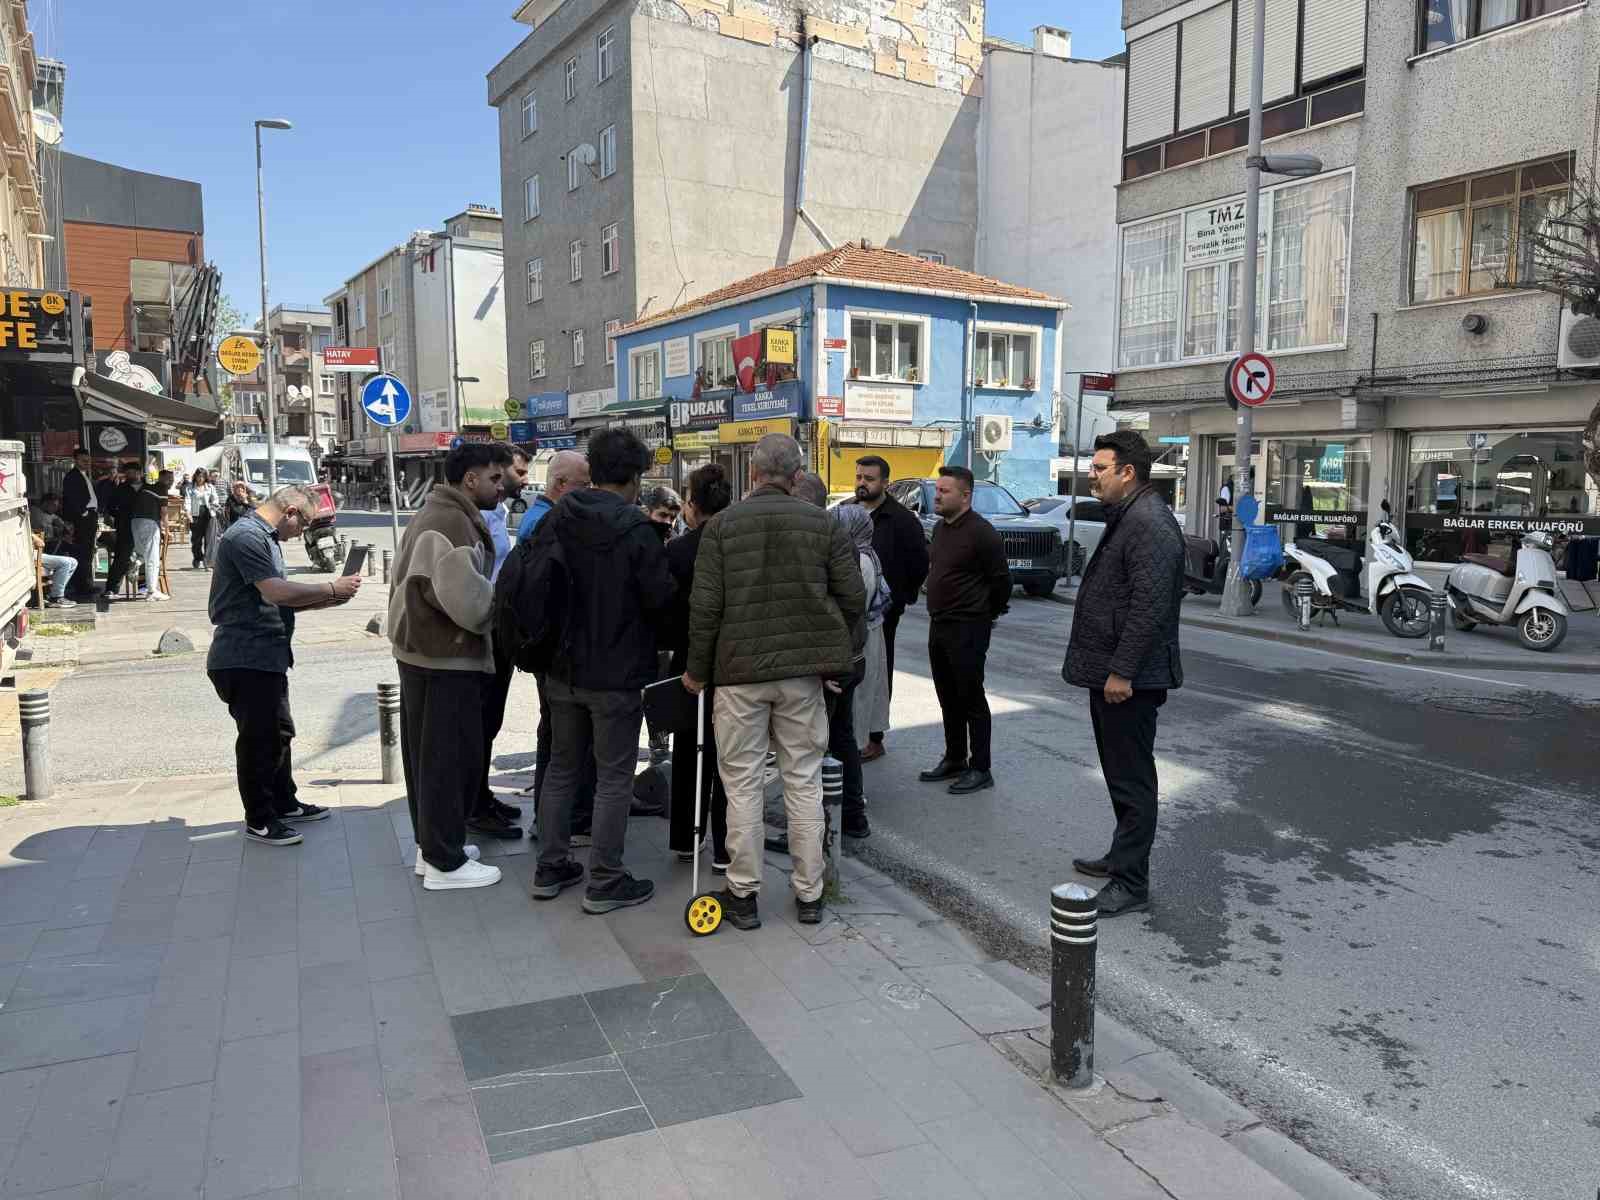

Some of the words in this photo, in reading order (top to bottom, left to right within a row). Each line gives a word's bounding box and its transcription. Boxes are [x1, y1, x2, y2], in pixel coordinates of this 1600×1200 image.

[1208, 203, 1245, 225] TMZ
[1197, 229, 1216, 239] Bina
[1218, 222, 1246, 233] Yöneti
[1188, 241, 1219, 253] Temizlik
[46, 295, 59, 305] BK
[769, 337, 790, 345] KANKA
[771, 344, 788, 353] TEKEL
[326, 350, 353, 360] HATAY
[754, 391, 773, 402] KANKA
[680, 399, 728, 425] BURAK
[742, 403, 757, 413] TEKEL
[1273, 512, 1299, 522] BAĞLAR
[1301, 514, 1323, 522] ERKEK
[1324, 514, 1358, 524] KUAFÖRÜ
[1443, 517, 1485, 529] BAĞLAR
[1487, 519, 1525, 530] ERKEK
[1527, 520, 1584, 533] KUAFÖRÜ
